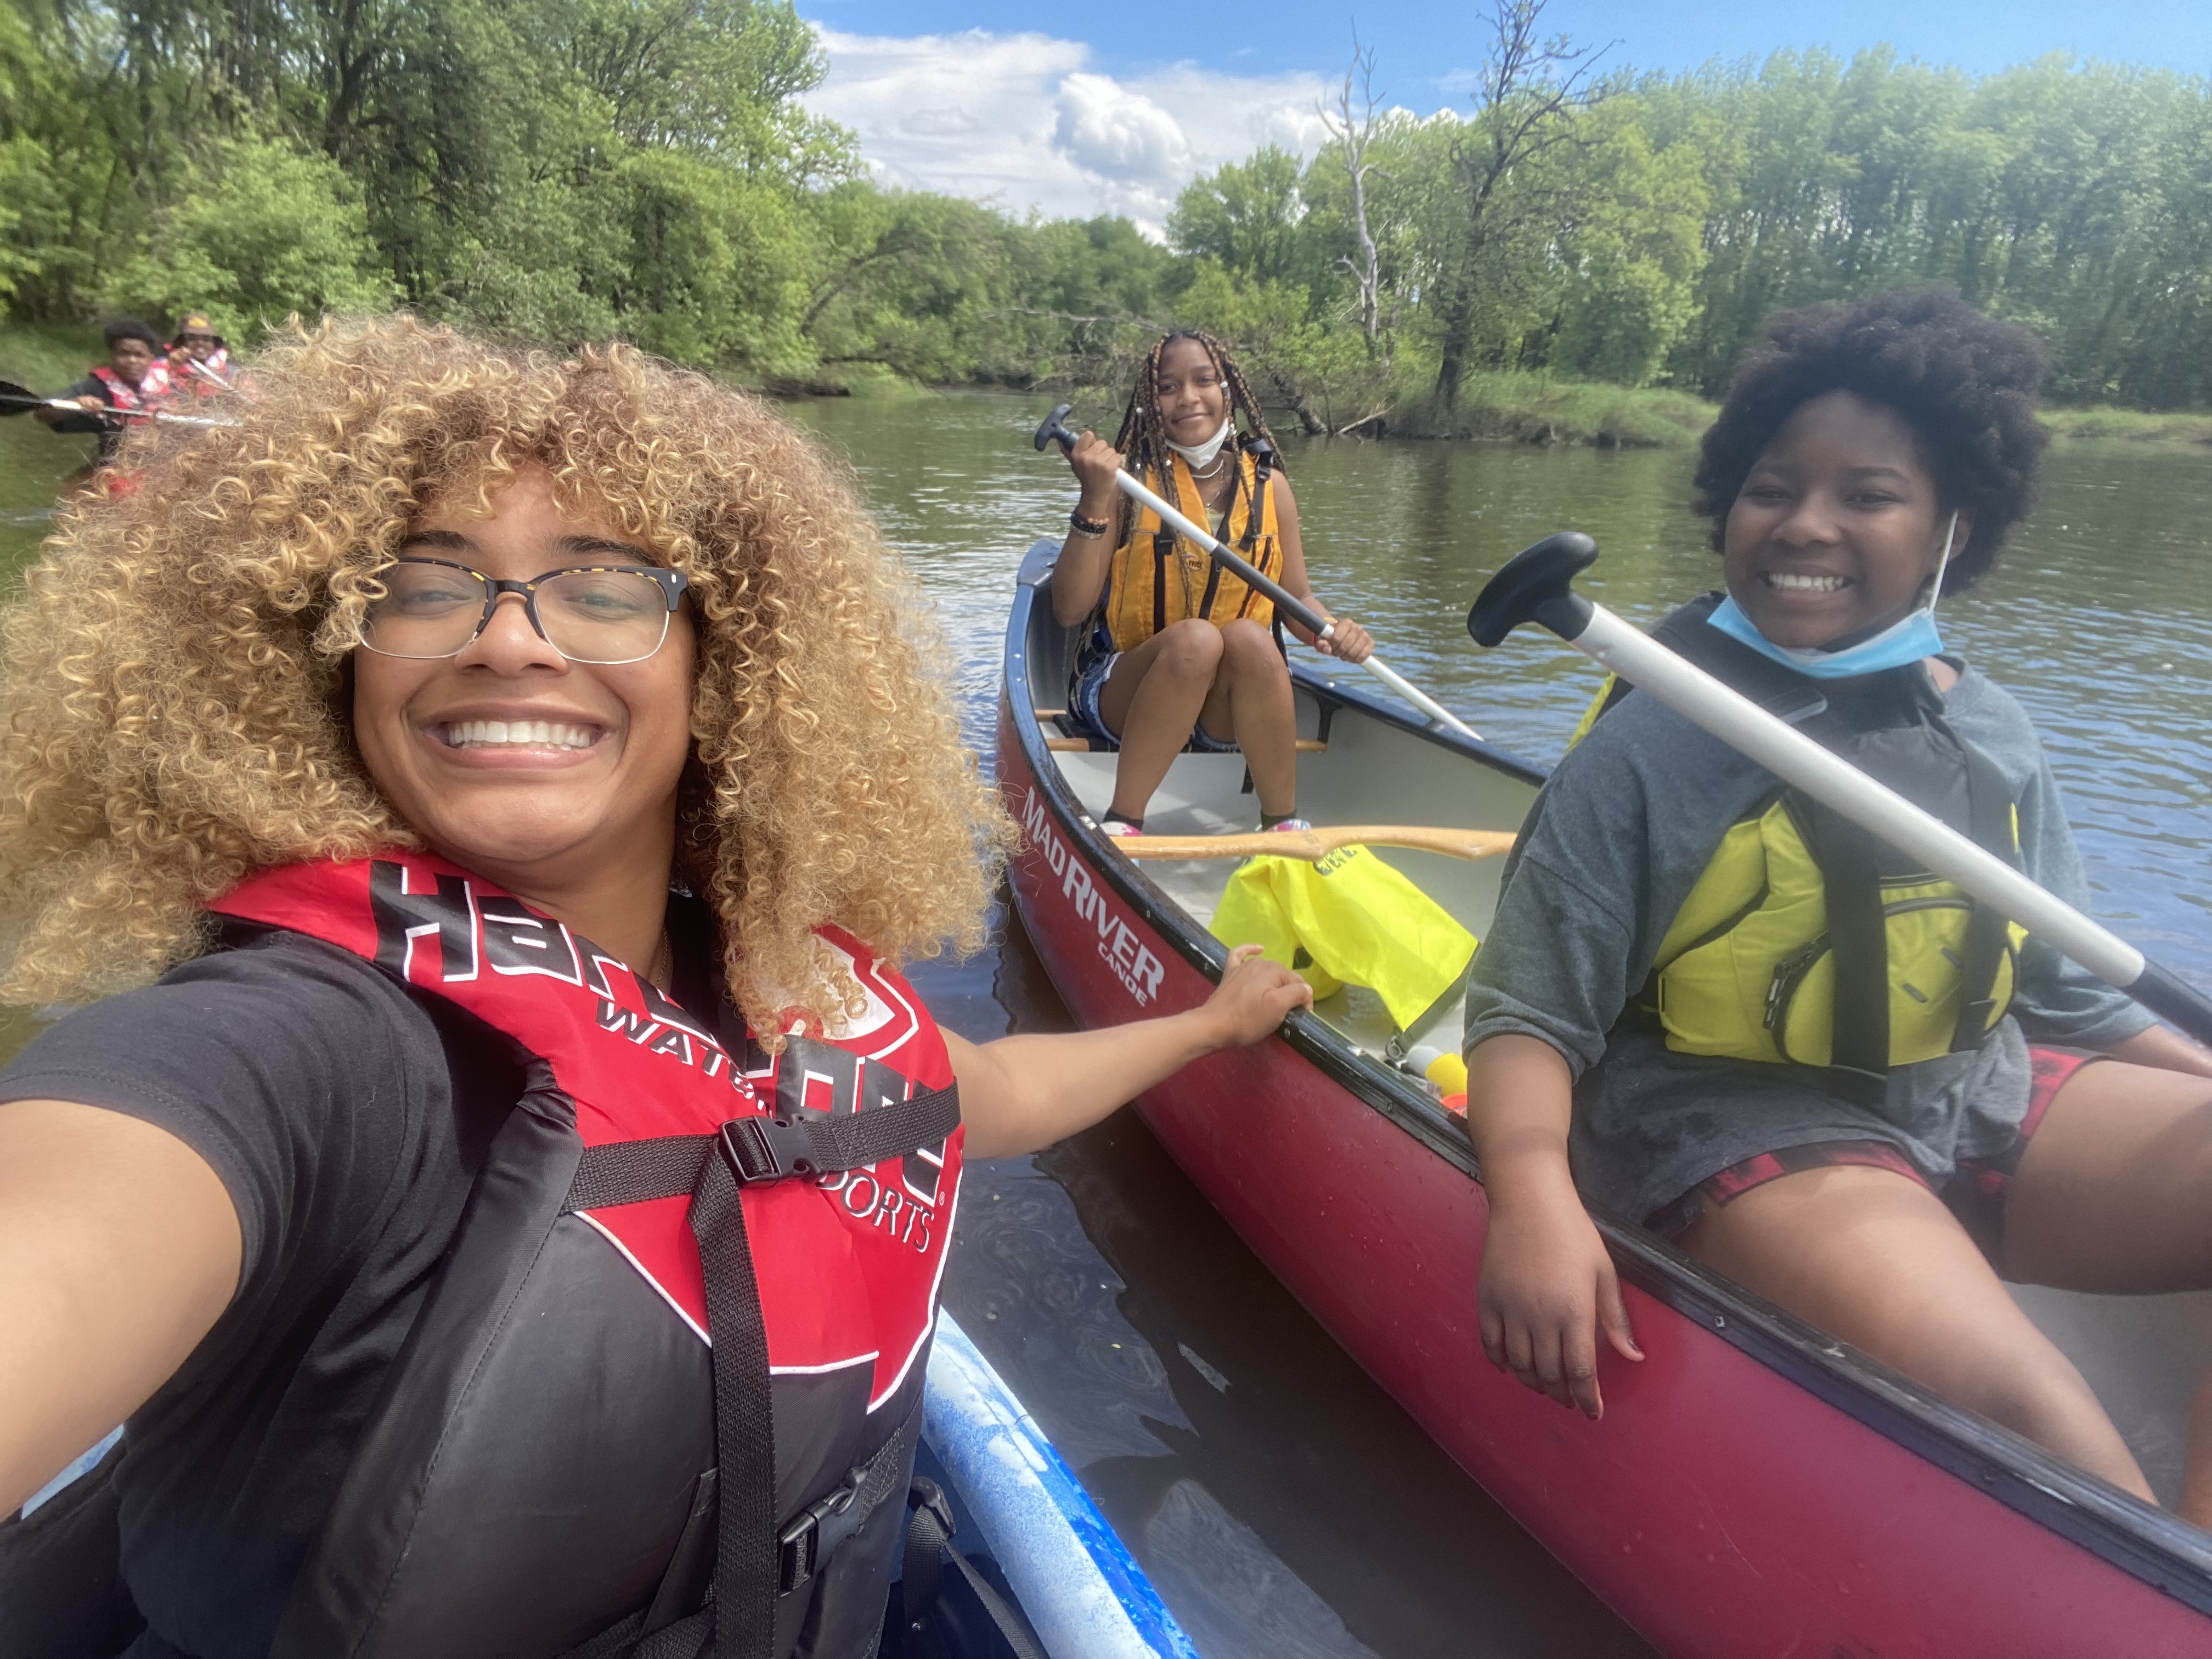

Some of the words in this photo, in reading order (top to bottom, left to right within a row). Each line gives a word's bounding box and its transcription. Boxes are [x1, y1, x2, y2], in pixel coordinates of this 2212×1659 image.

[1022, 786, 1066, 877] MAD
[1062, 854, 1165, 1001] RIVER
[1098, 942, 1149, 1007] CANOE
